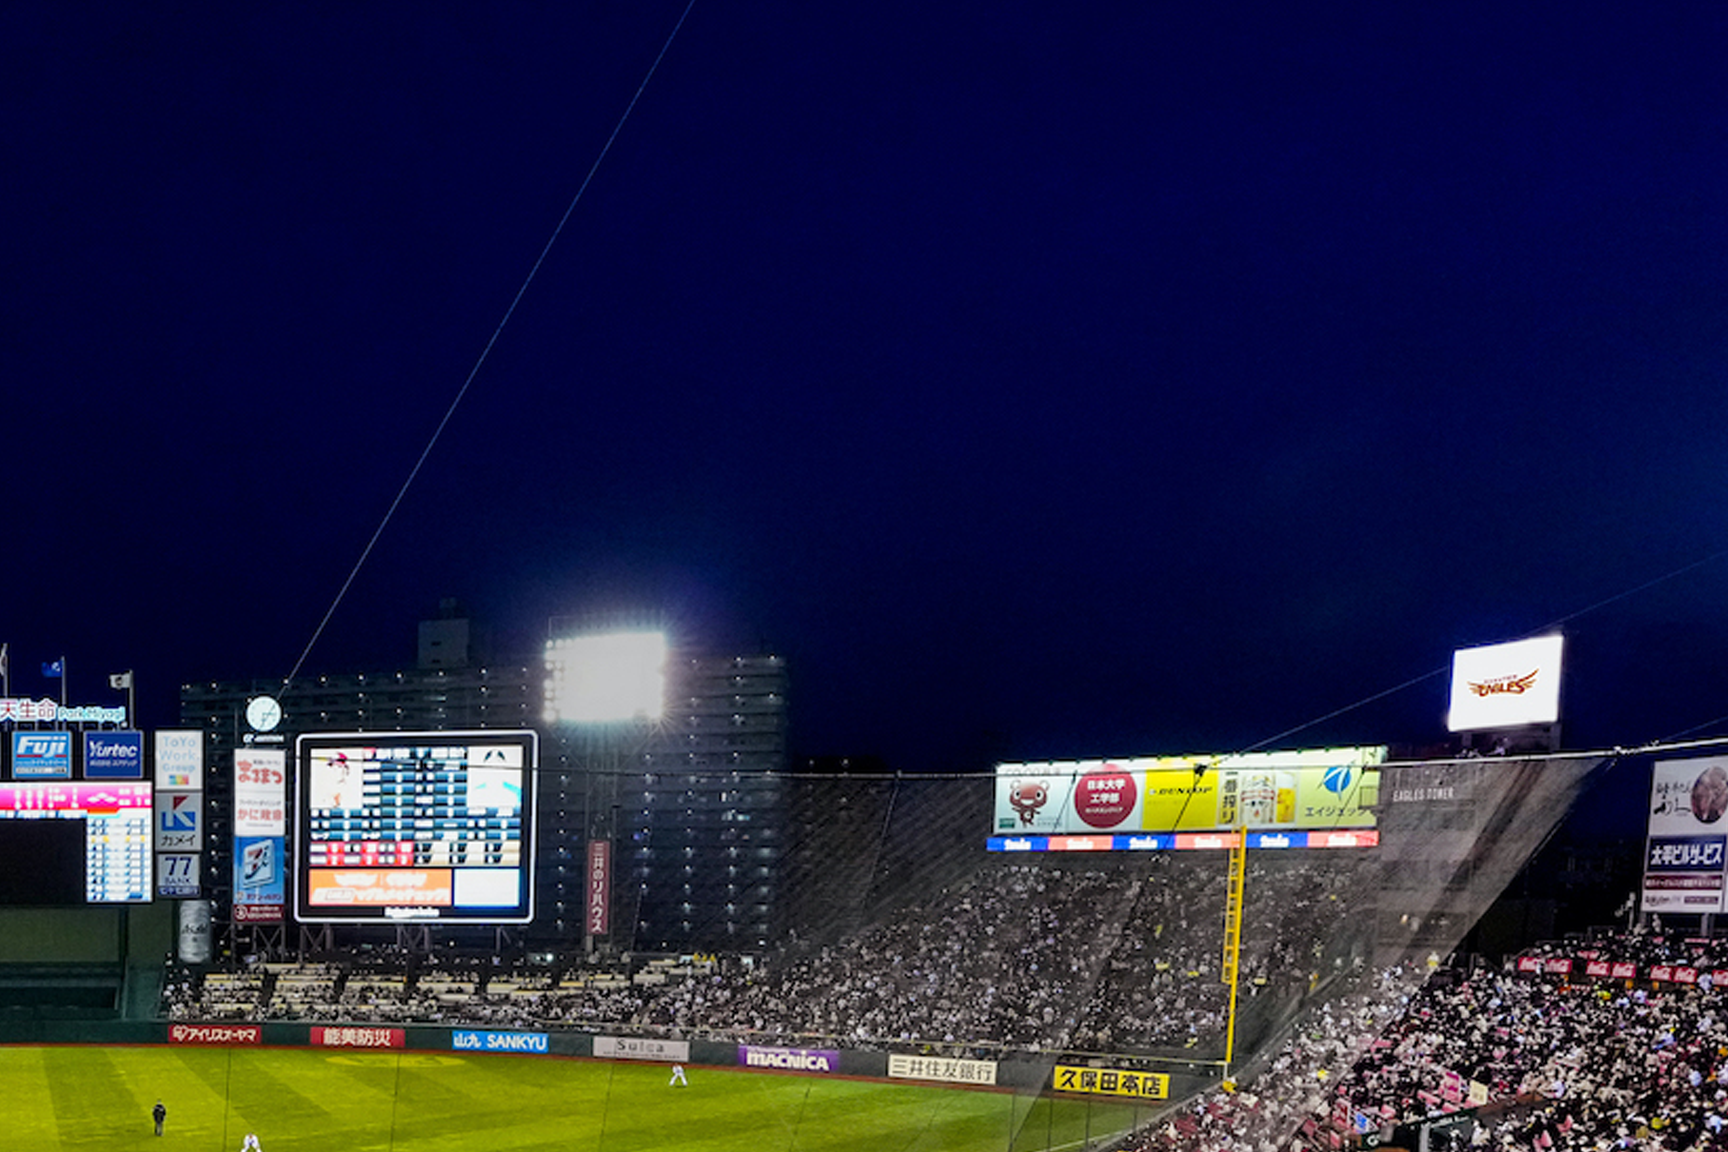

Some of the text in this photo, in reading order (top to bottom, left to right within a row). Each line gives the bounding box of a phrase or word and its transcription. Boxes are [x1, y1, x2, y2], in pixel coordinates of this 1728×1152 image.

[1477, 679, 1526, 697] EAGLES
[16, 736, 67, 757] Fuji
[89, 741, 138, 757] Yurtec
[163, 735, 196, 748] ToYo
[163, 763, 196, 773] Group
[1087, 779, 1125, 791] 日本大学
[1090, 792, 1120, 804] 工学部
[161, 835, 196, 847] カメイ
[1650, 843, 1723, 866] 太平ビルサービス
[165, 857, 192, 876] 77
[323, 1028, 391, 1047] 能美防災
[487, 1033, 548, 1051] SANKYU
[617, 1038, 666, 1054] Suica
[891, 1057, 995, 1082] 三井住友銀行
[1060, 1069, 1162, 1098] 久保田本店
